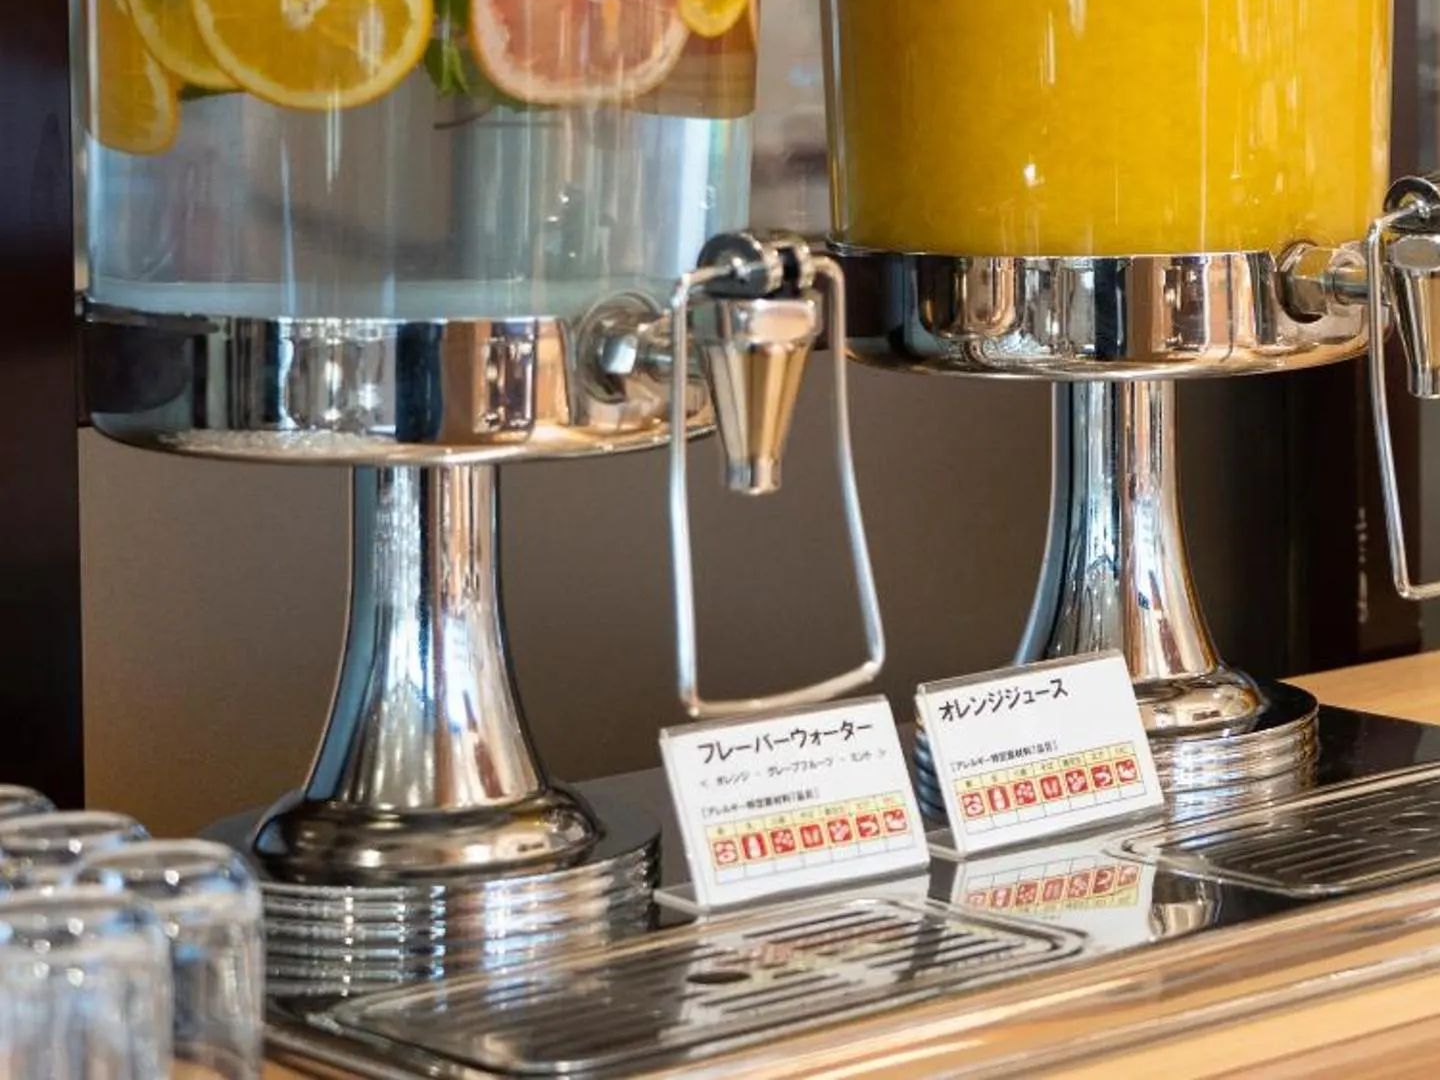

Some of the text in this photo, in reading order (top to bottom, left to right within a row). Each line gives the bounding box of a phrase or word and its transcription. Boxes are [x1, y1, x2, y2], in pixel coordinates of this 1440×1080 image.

[938, 678, 1069, 722] オレンジジュース
[696, 720, 873, 763] フレーバーウォーター
